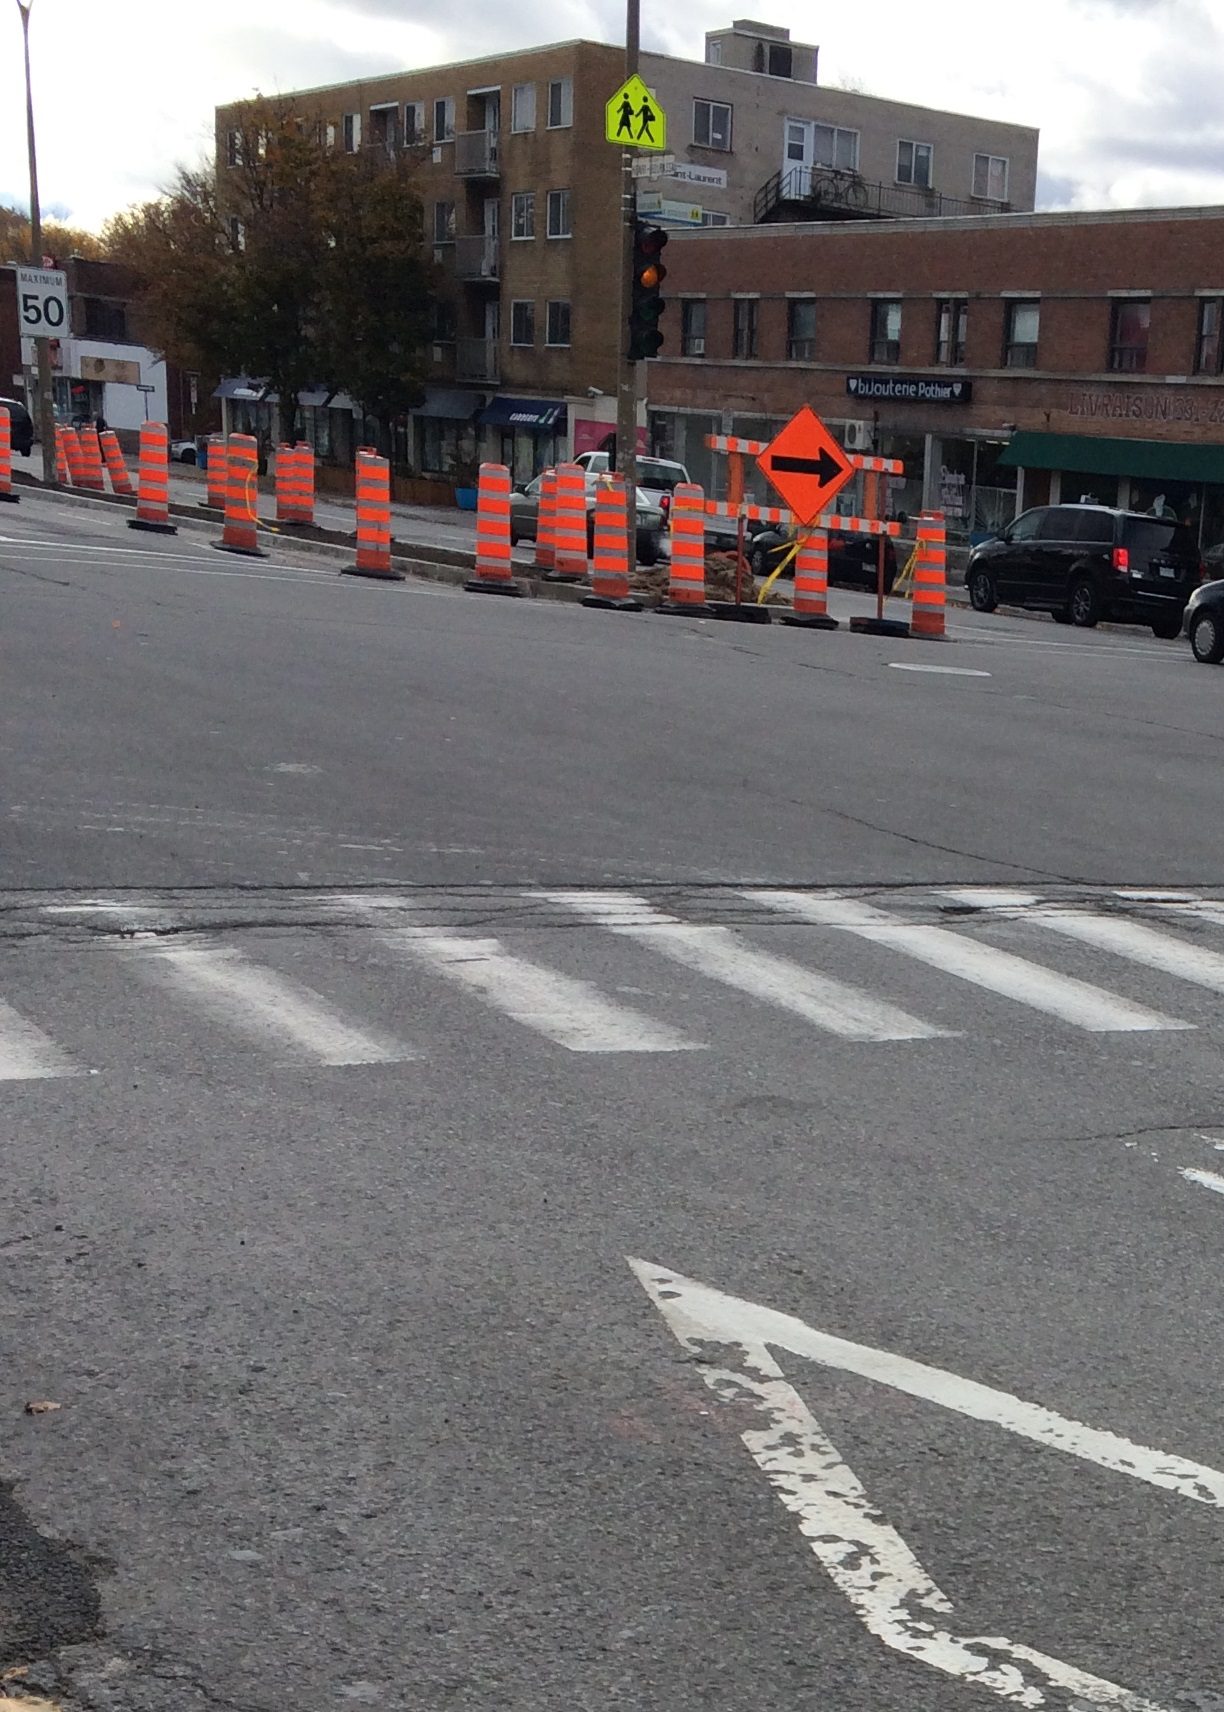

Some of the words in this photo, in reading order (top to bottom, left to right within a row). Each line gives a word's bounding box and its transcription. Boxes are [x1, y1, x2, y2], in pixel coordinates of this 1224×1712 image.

[20, 273, 62, 286] MAXIMUM
[22, 294, 64, 327] 50
[918, 382, 952, 398] Pothier
[1068, 393, 1170, 420] LIVRAISON
